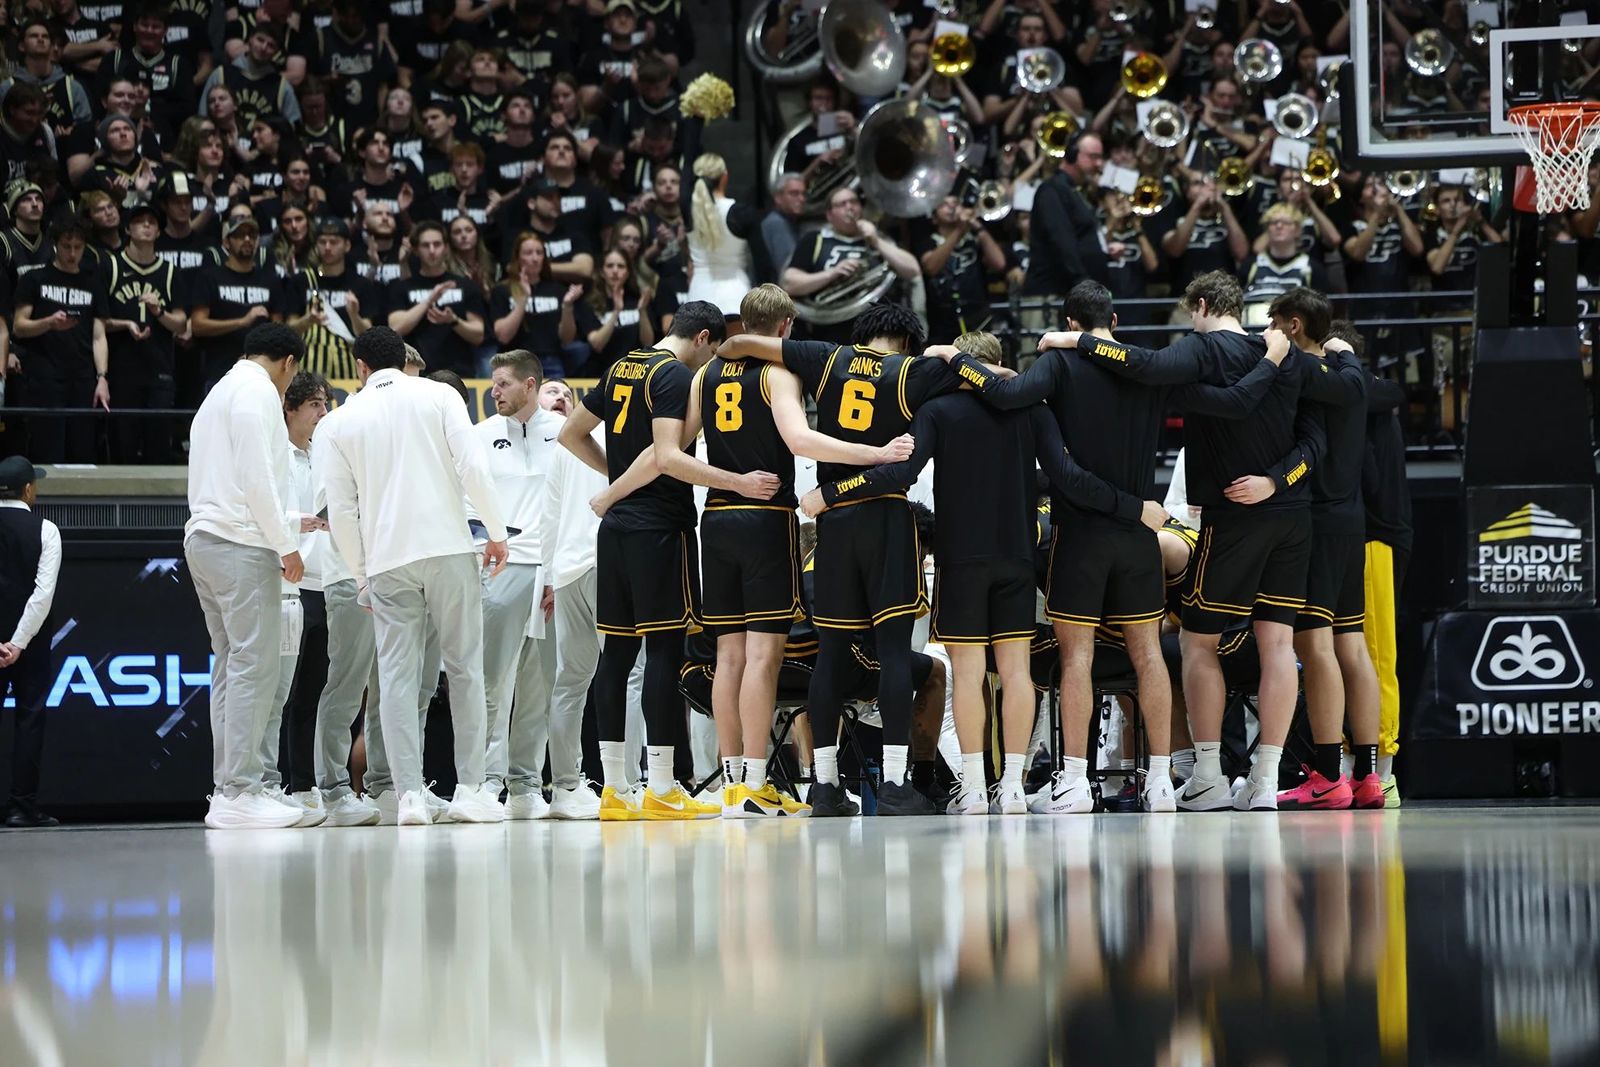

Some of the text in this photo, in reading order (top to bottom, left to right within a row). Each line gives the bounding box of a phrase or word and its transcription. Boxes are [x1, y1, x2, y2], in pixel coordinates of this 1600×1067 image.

[345, 79, 363, 105] 3
[41, 285, 93, 305] PAINT CREW
[219, 286, 271, 304] PAINT CREW
[1094, 342, 1128, 363] IOWA
[720, 361, 747, 378] KOCH
[848, 356, 883, 378] BANKS
[958, 363, 990, 388] IOWA
[612, 383, 633, 434] 7
[715, 381, 743, 433] 8
[837, 379, 877, 432] 6
[1286, 460, 1308, 487] IOWA
[835, 474, 867, 495] IOWA
[1479, 544, 1582, 564] PURDUE
[1479, 564, 1582, 582] FEDERAL
[1479, 582, 1583, 593] CREDIT UNION
[1456, 701, 1600, 735] PIONEER
